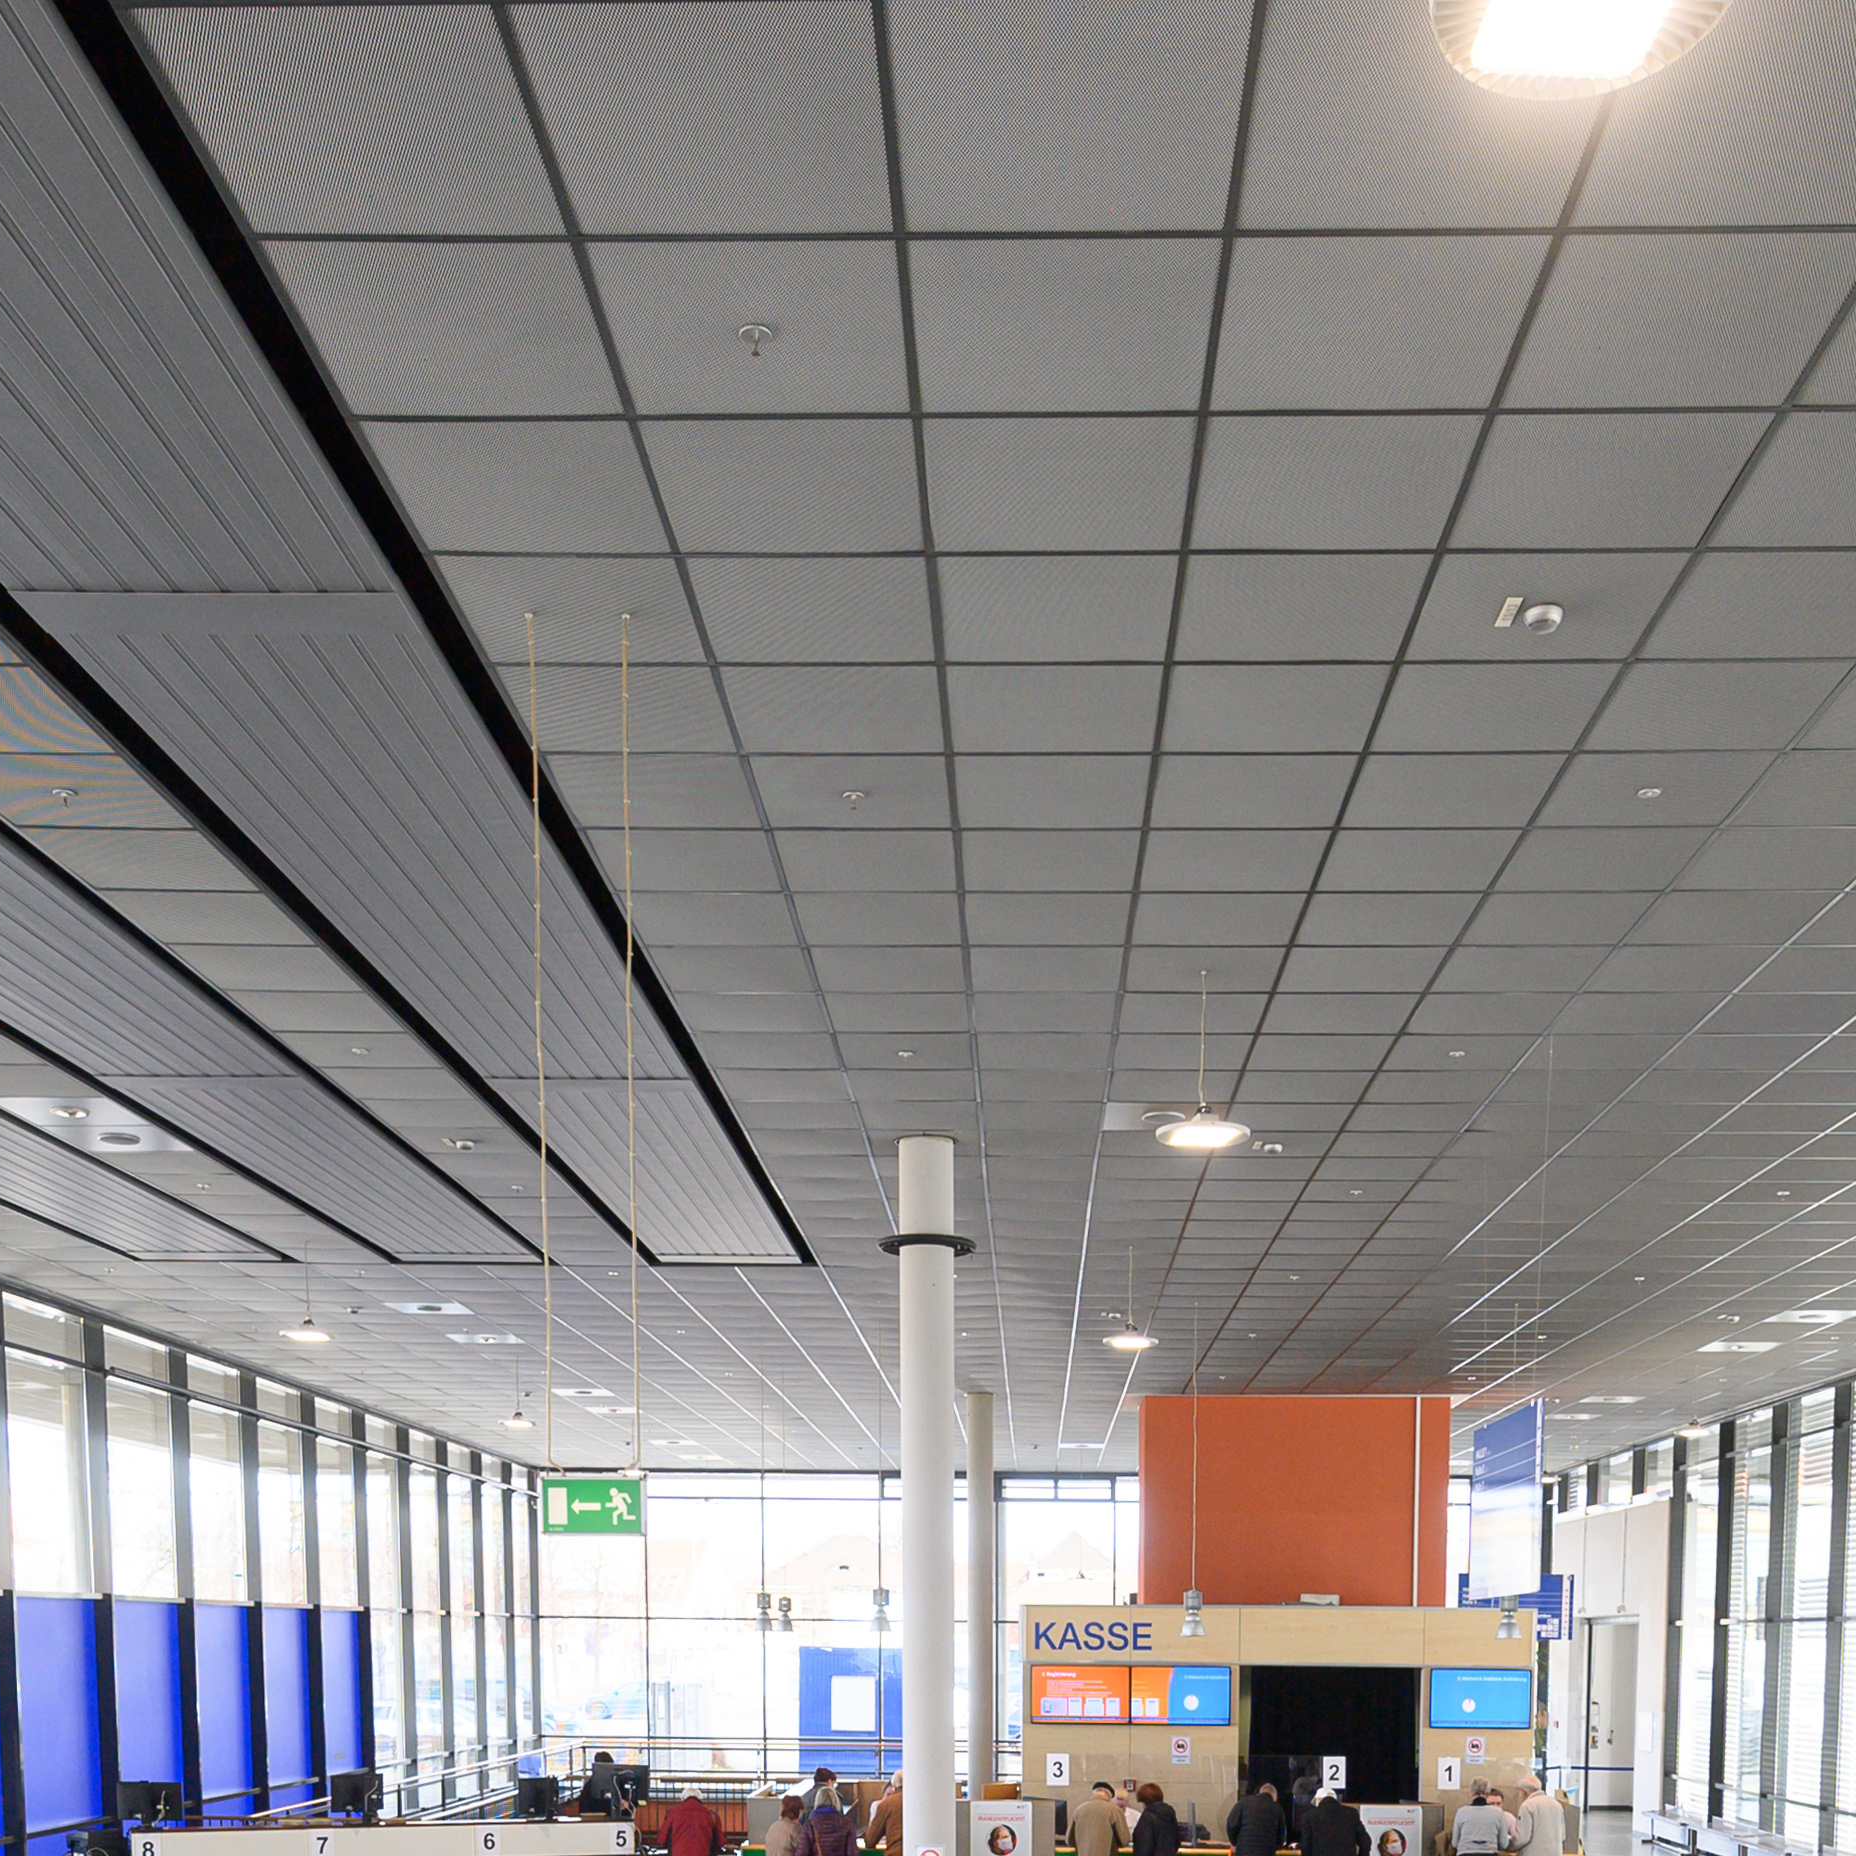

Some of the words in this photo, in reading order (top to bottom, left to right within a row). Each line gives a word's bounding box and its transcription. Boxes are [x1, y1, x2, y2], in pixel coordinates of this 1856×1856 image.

[1034, 1622, 1153, 1651] KASSE
[1052, 1761, 1064, 1778] 3
[1328, 1764, 1341, 1781] 2
[1444, 1765, 1452, 1783] 1
[316, 1836, 329, 1855] 7
[483, 1833, 496, 1851] 6
[615, 1830, 627, 1848] 5
